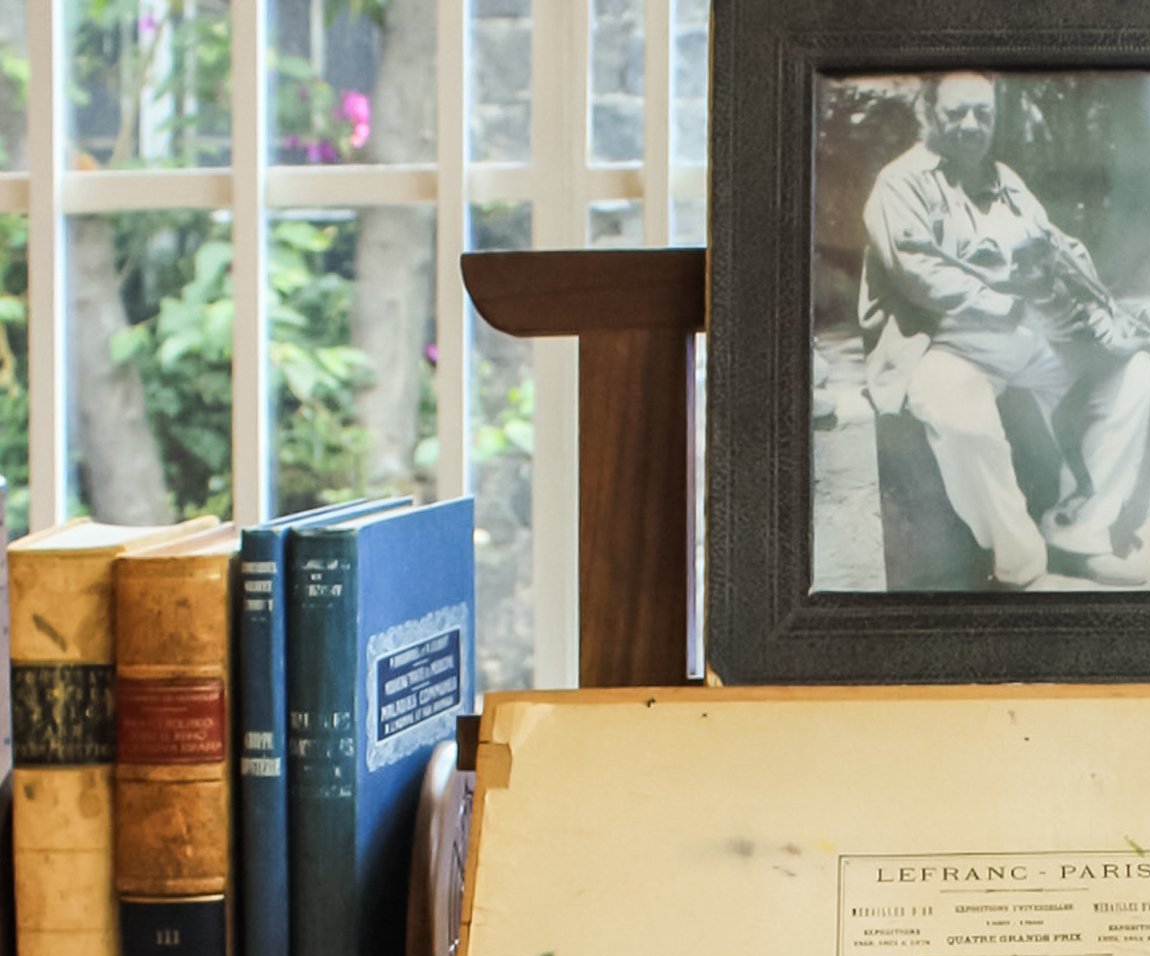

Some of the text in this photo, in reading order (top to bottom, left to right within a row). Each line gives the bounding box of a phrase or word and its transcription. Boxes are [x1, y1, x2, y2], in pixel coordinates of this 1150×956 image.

[877, 865, 1028, 883] LEFRANC
[156, 930, 180, 945] III
[947, 932, 1083, 946] QUATRE GRANDS PRIX
